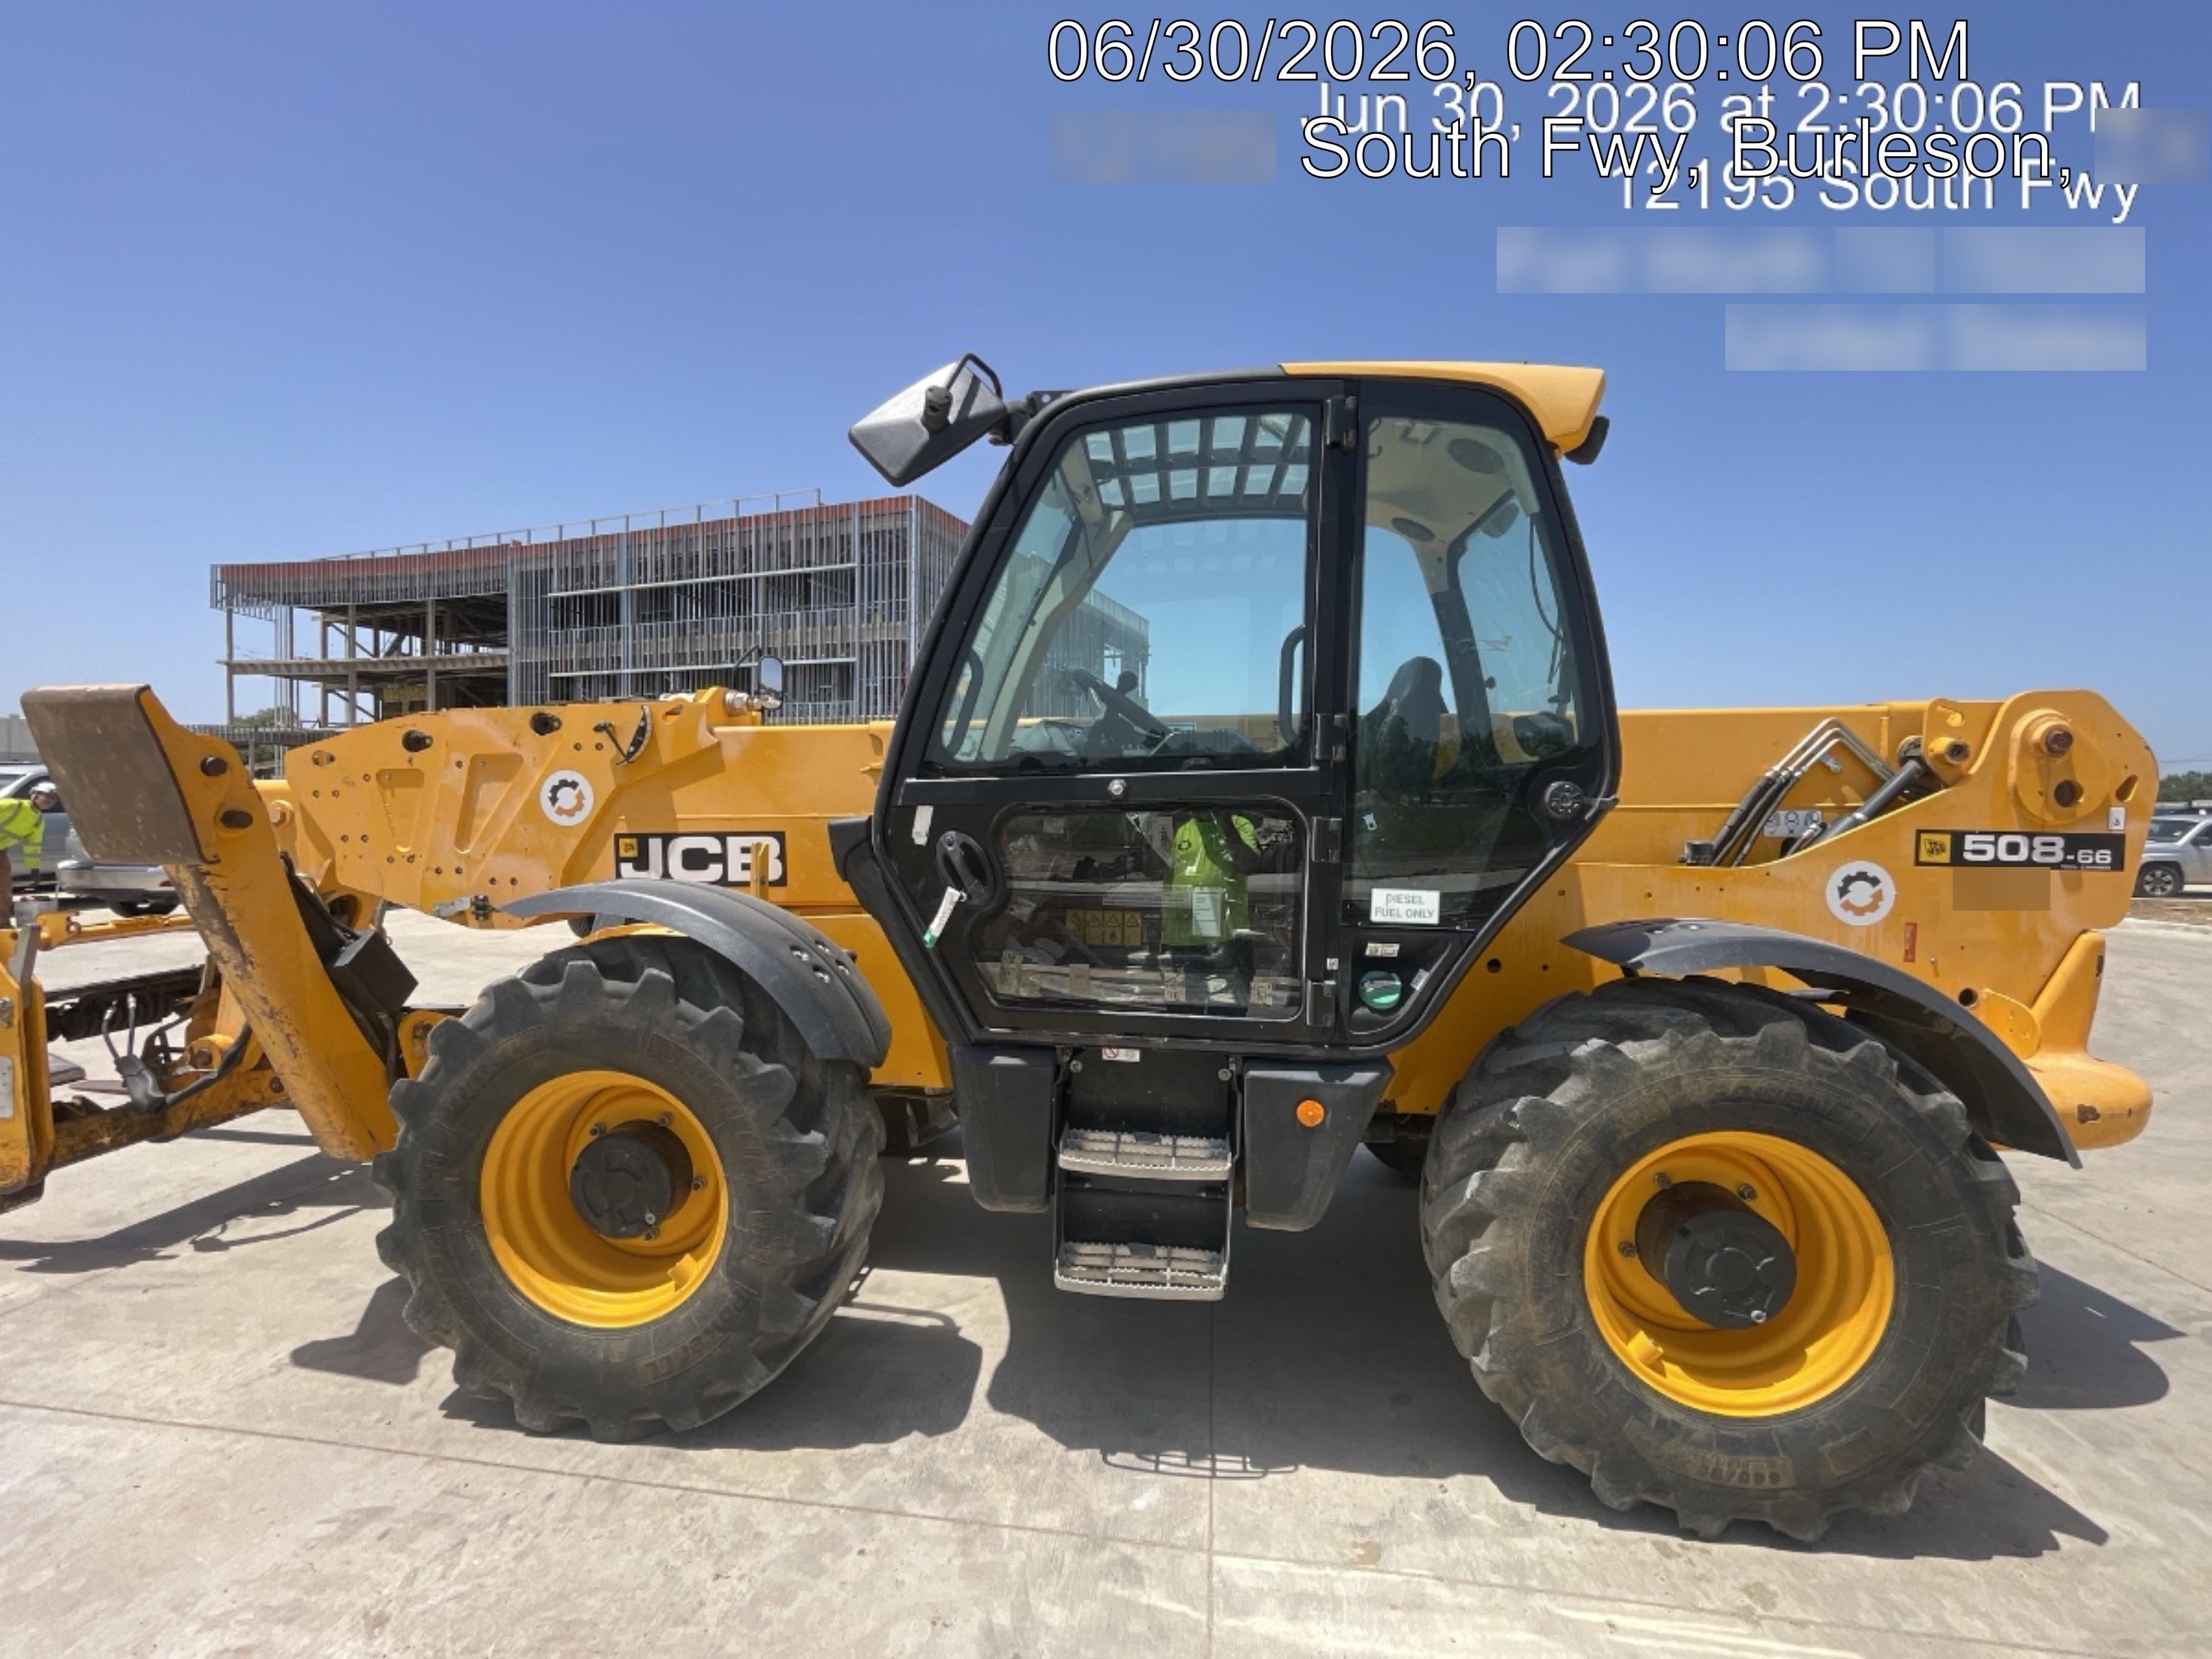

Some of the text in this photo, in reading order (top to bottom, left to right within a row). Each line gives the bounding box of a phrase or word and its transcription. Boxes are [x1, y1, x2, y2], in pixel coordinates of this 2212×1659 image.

[620, 836, 782, 881] JCB
[1963, 834, 2112, 864] 508-66
[1386, 893, 1425, 905] DIESEL
[1375, 907, 1435, 919] FUEL ONLY
